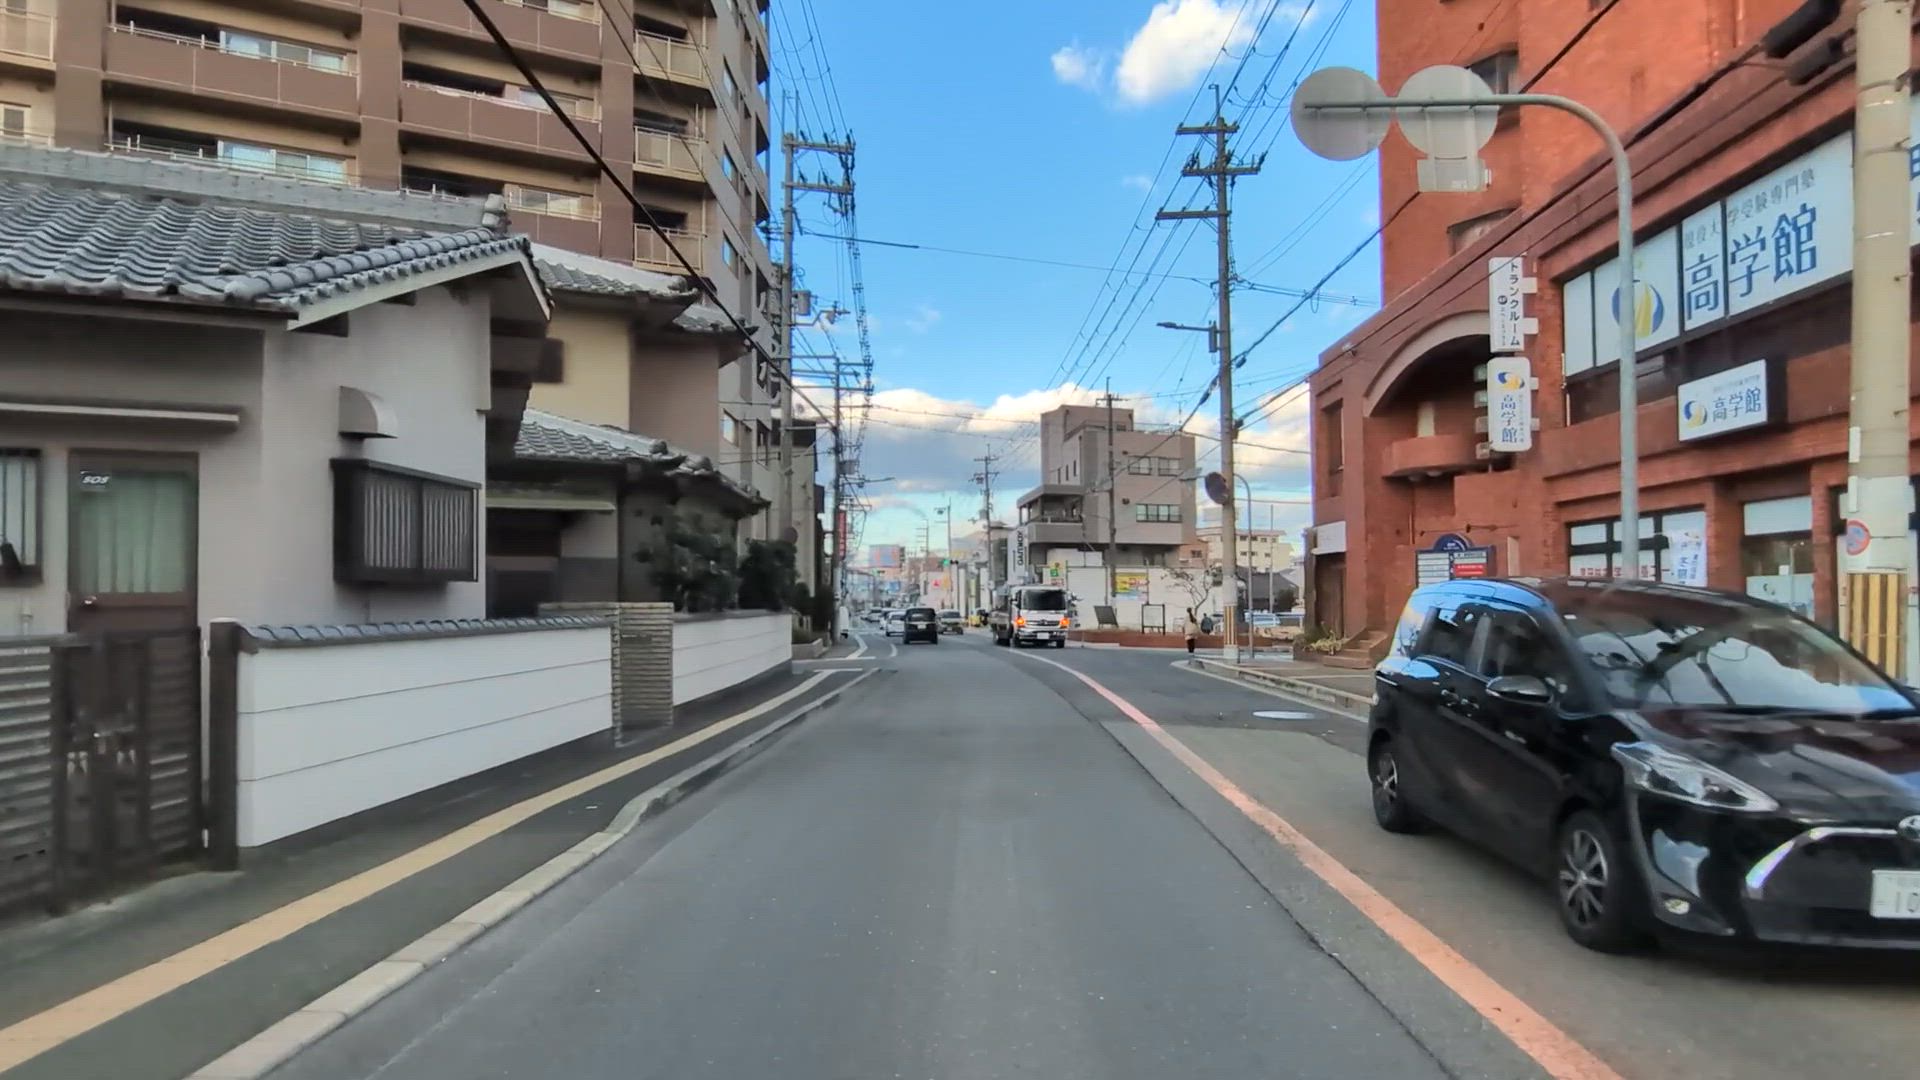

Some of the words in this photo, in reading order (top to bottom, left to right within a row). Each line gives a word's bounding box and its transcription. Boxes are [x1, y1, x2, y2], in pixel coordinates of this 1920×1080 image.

[1685, 203, 1817, 320] 高学館
[1509, 262, 1520, 346] トランクルーム
[1501, 394, 1517, 443] 高学館
[1712, 387, 1762, 422] 高学館
